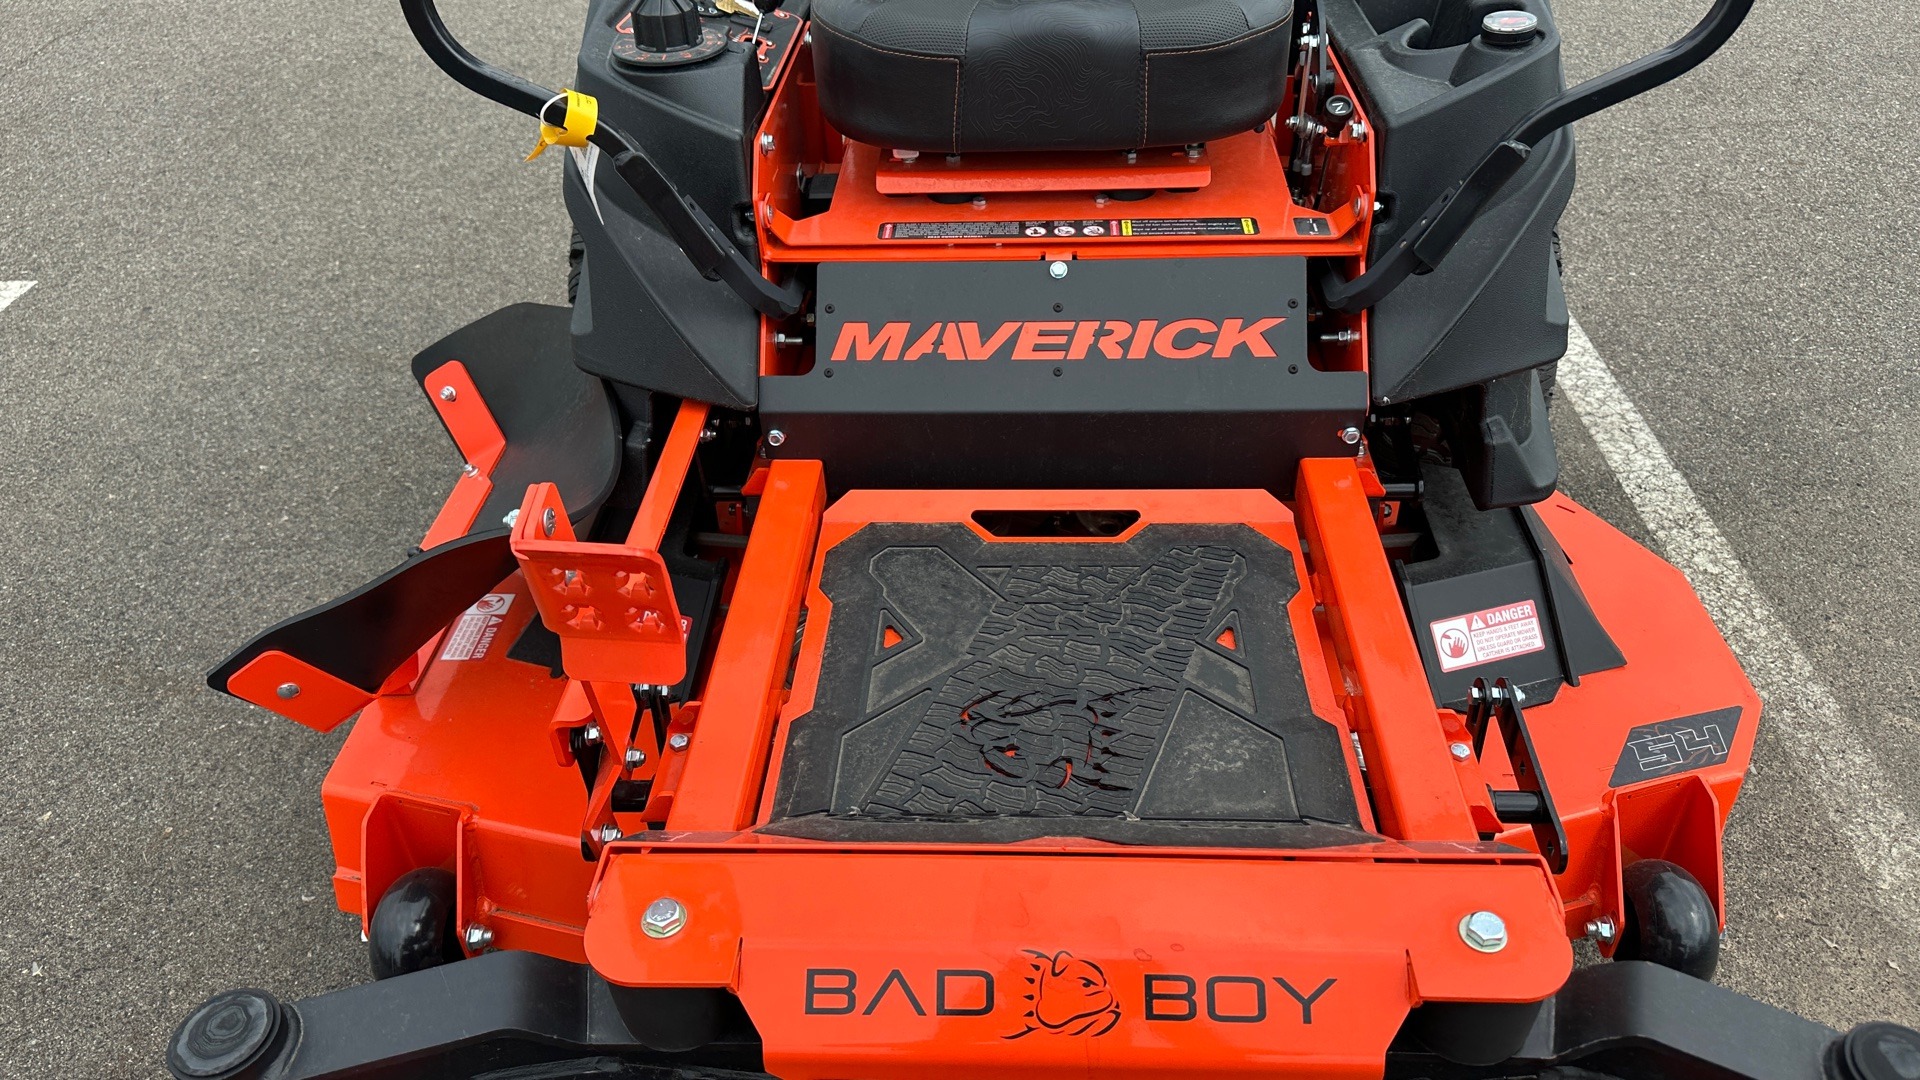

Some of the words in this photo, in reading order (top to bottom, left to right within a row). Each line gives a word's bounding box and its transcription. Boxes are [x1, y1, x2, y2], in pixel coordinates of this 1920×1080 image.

[830, 317, 1288, 361] MAVERICK
[1486, 604, 1533, 625] DANGER
[1486, 627, 1503, 635] HANDS
[1495, 631, 1516, 640] OPERATE
[1517, 627, 1535, 635] MOWER
[471, 627, 498, 659] DANGER
[1477, 643, 1496, 652] UNLESS
[1497, 639, 1513, 647] GUARD
[1522, 634, 1538, 642] GRASS
[1483, 649, 1505, 658] CATCHER
[1627, 724, 1728, 771] 54
[804, 968, 995, 1017] BAD
[1144, 973, 1337, 1025] BOY
